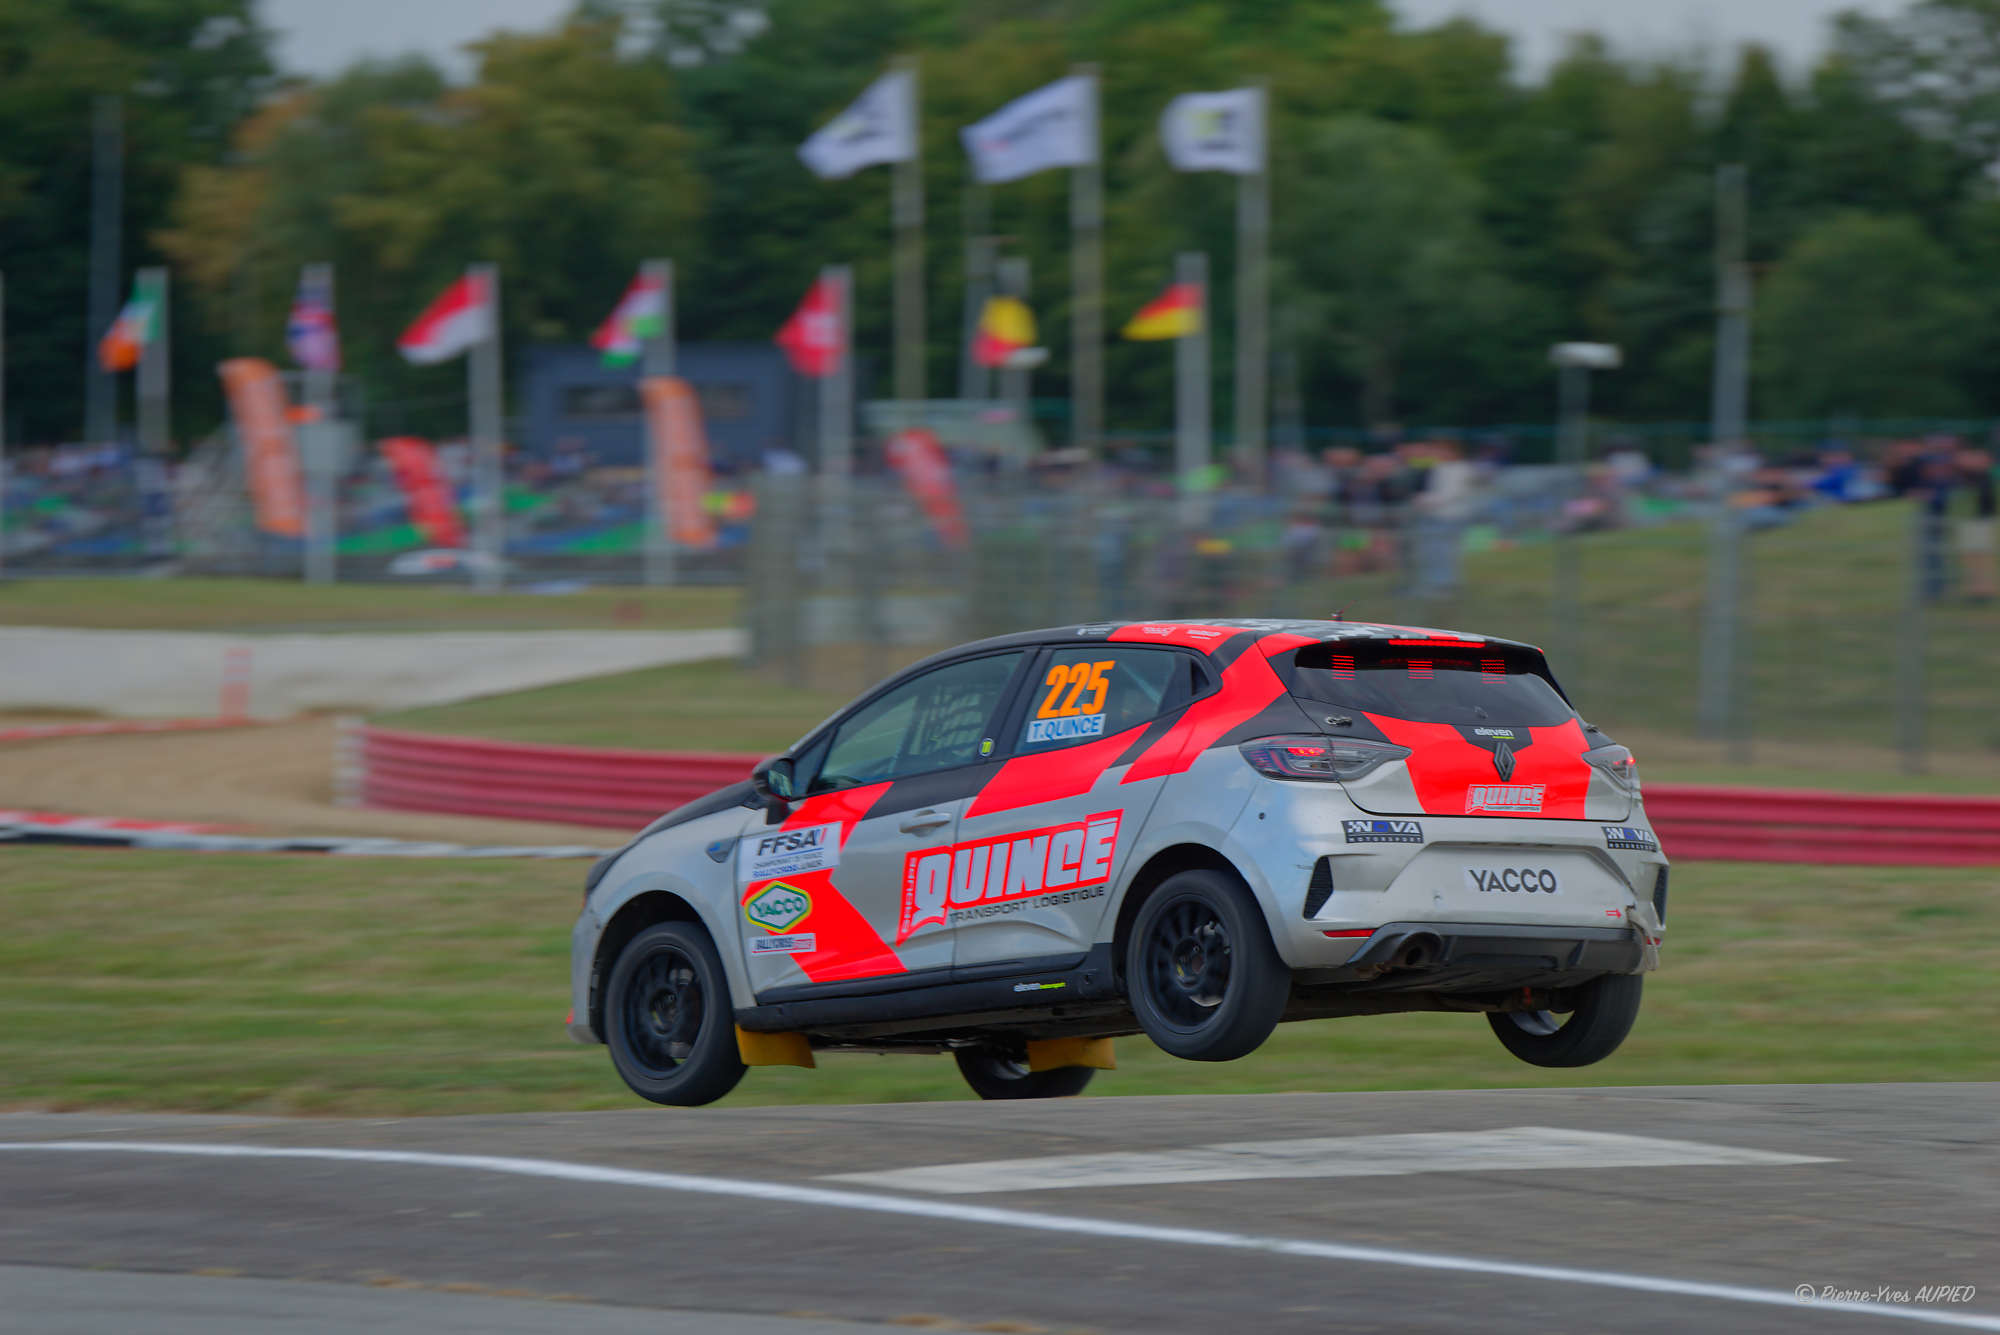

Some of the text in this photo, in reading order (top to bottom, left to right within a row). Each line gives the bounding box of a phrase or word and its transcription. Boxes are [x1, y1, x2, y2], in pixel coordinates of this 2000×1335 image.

[1036, 660, 1116, 719] 225
[1032, 716, 1102, 741] T.QUINCE
[1474, 727, 1514, 737] eleven
[757, 829, 820, 856] FFSA
[1468, 868, 1557, 894] YACCO
[751, 896, 803, 918] YACCO
[950, 886, 1104, 924] TRANSPORT LOGISTIQUE
